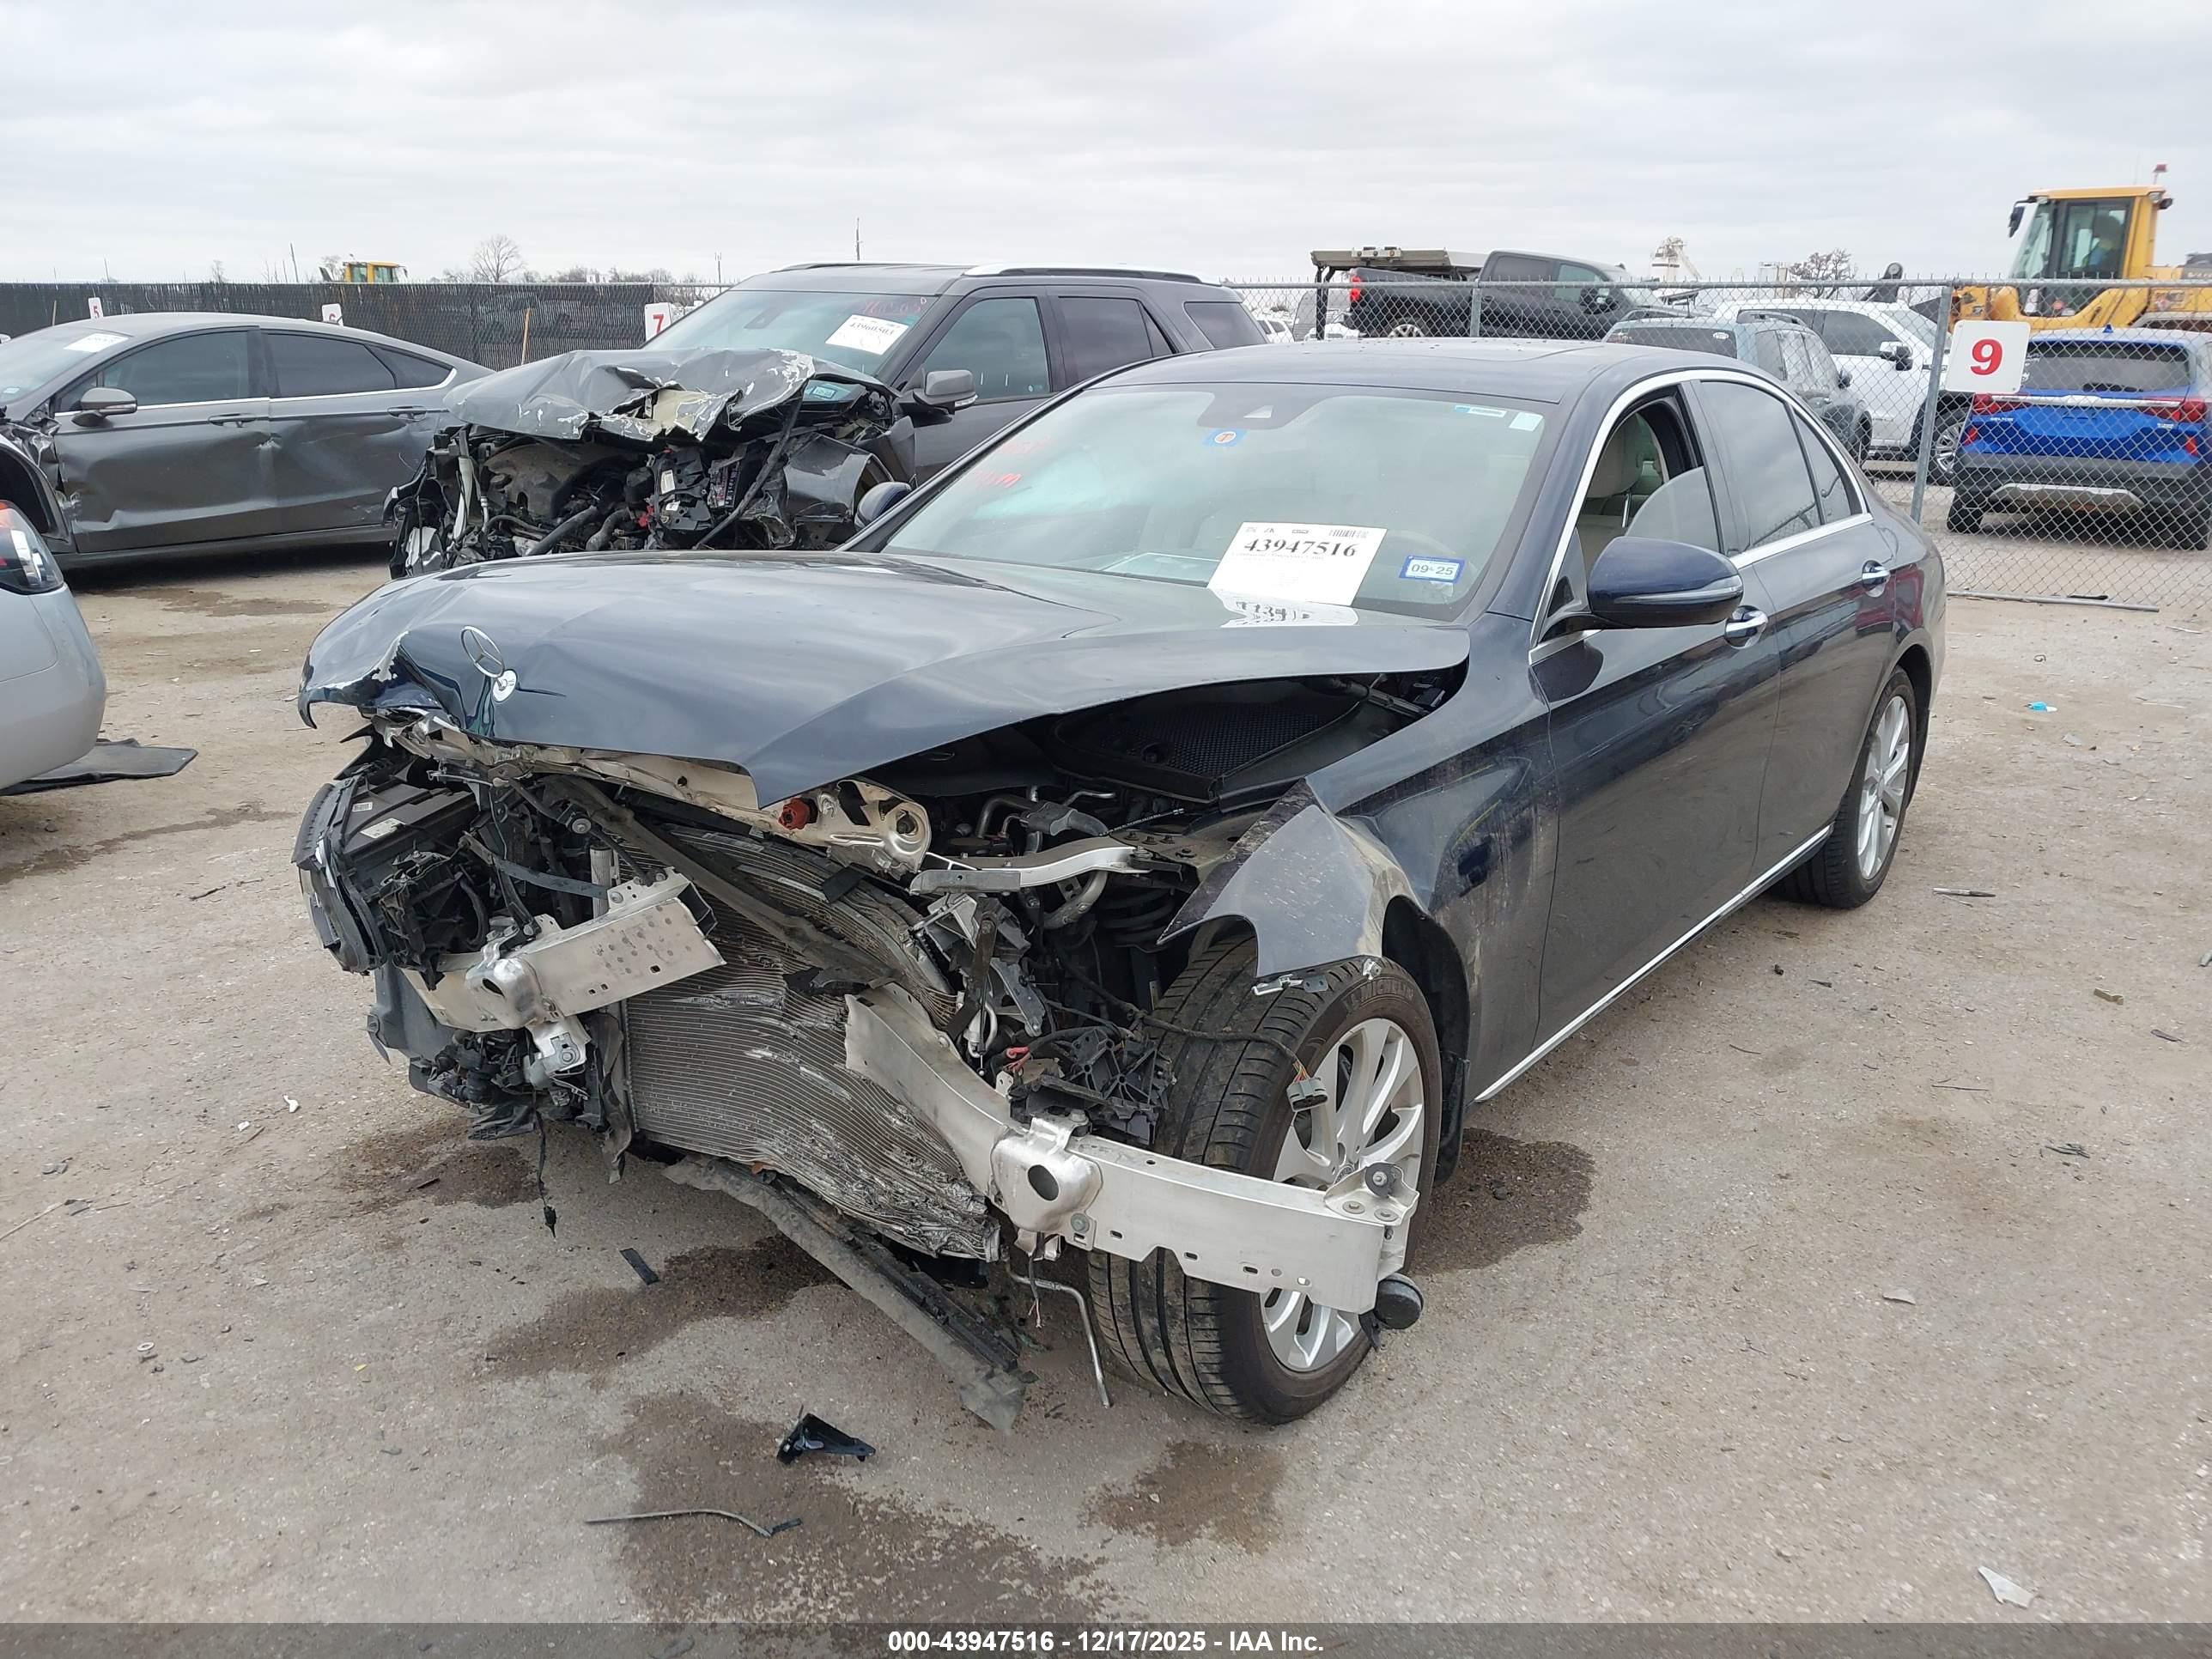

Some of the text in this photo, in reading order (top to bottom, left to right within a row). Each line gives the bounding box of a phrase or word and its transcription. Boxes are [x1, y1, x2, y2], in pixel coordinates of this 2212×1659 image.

[653, 313, 665, 335] 7
[1970, 338, 2003, 376] 9
[1244, 538, 1360, 557] 43947516
